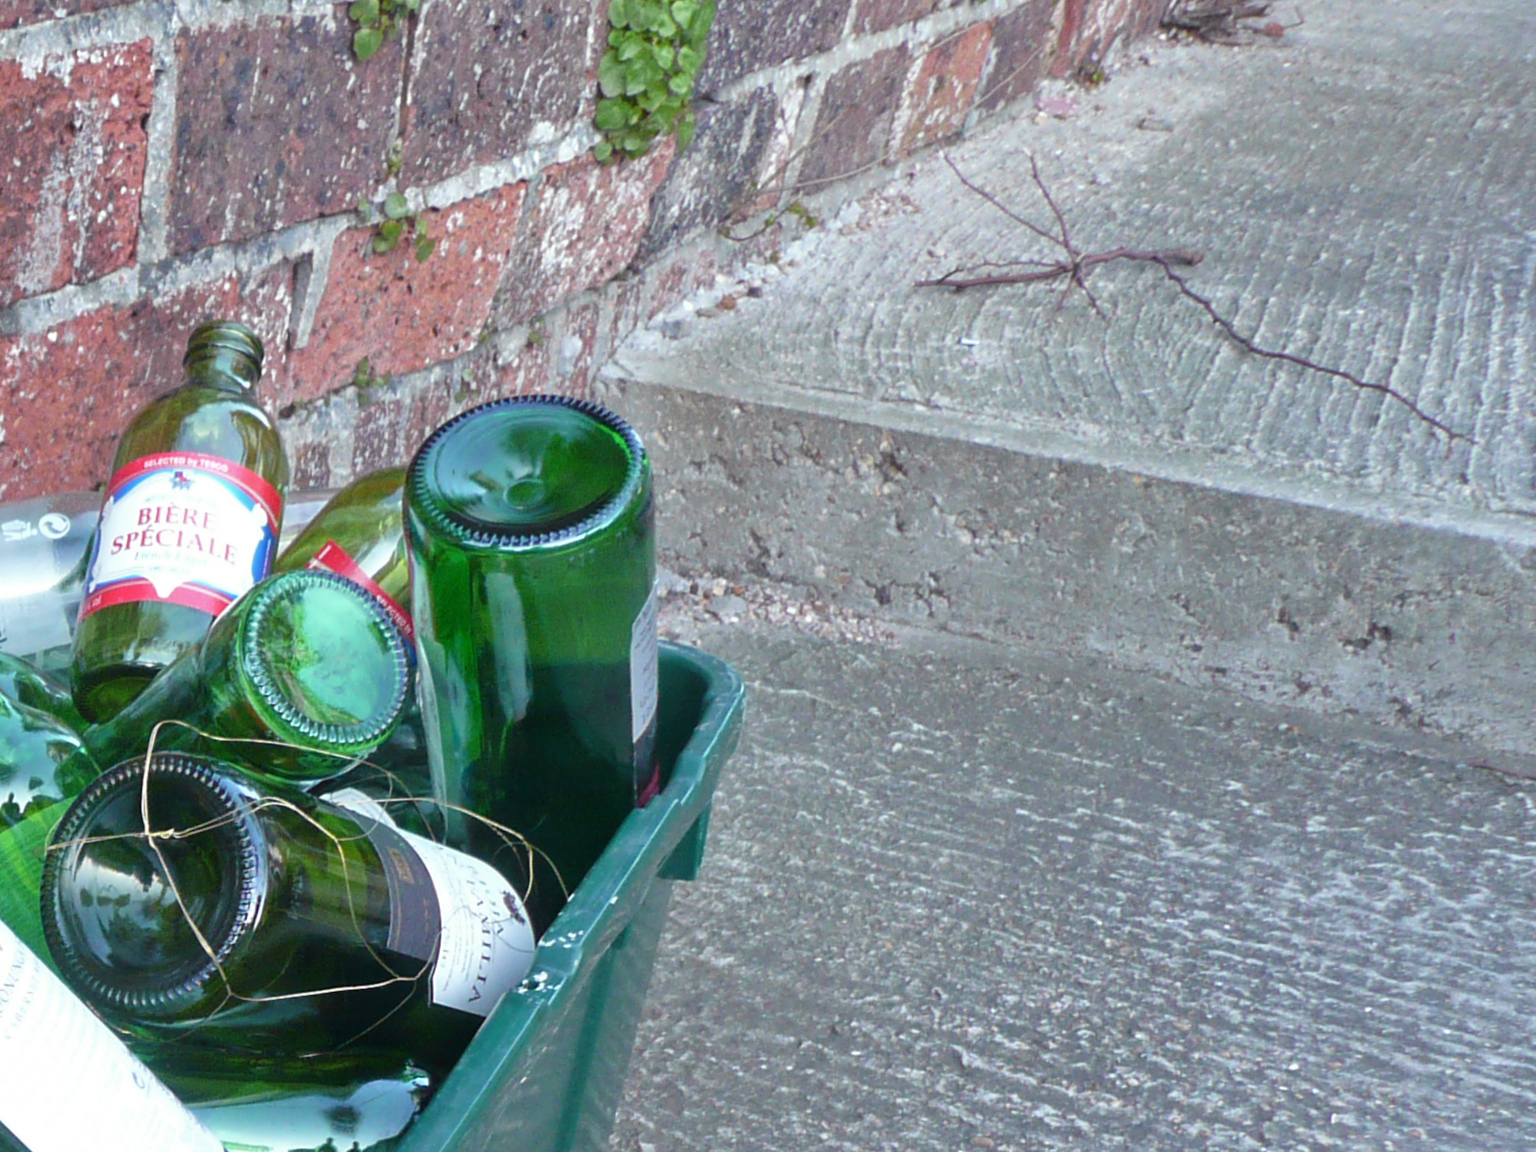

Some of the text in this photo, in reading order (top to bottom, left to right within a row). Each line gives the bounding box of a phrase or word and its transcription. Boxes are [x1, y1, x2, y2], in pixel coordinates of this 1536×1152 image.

[200, 459, 228, 473] TESCO
[137, 501, 216, 529] BIÈRE
[110, 525, 238, 565] SPÉCIALE
